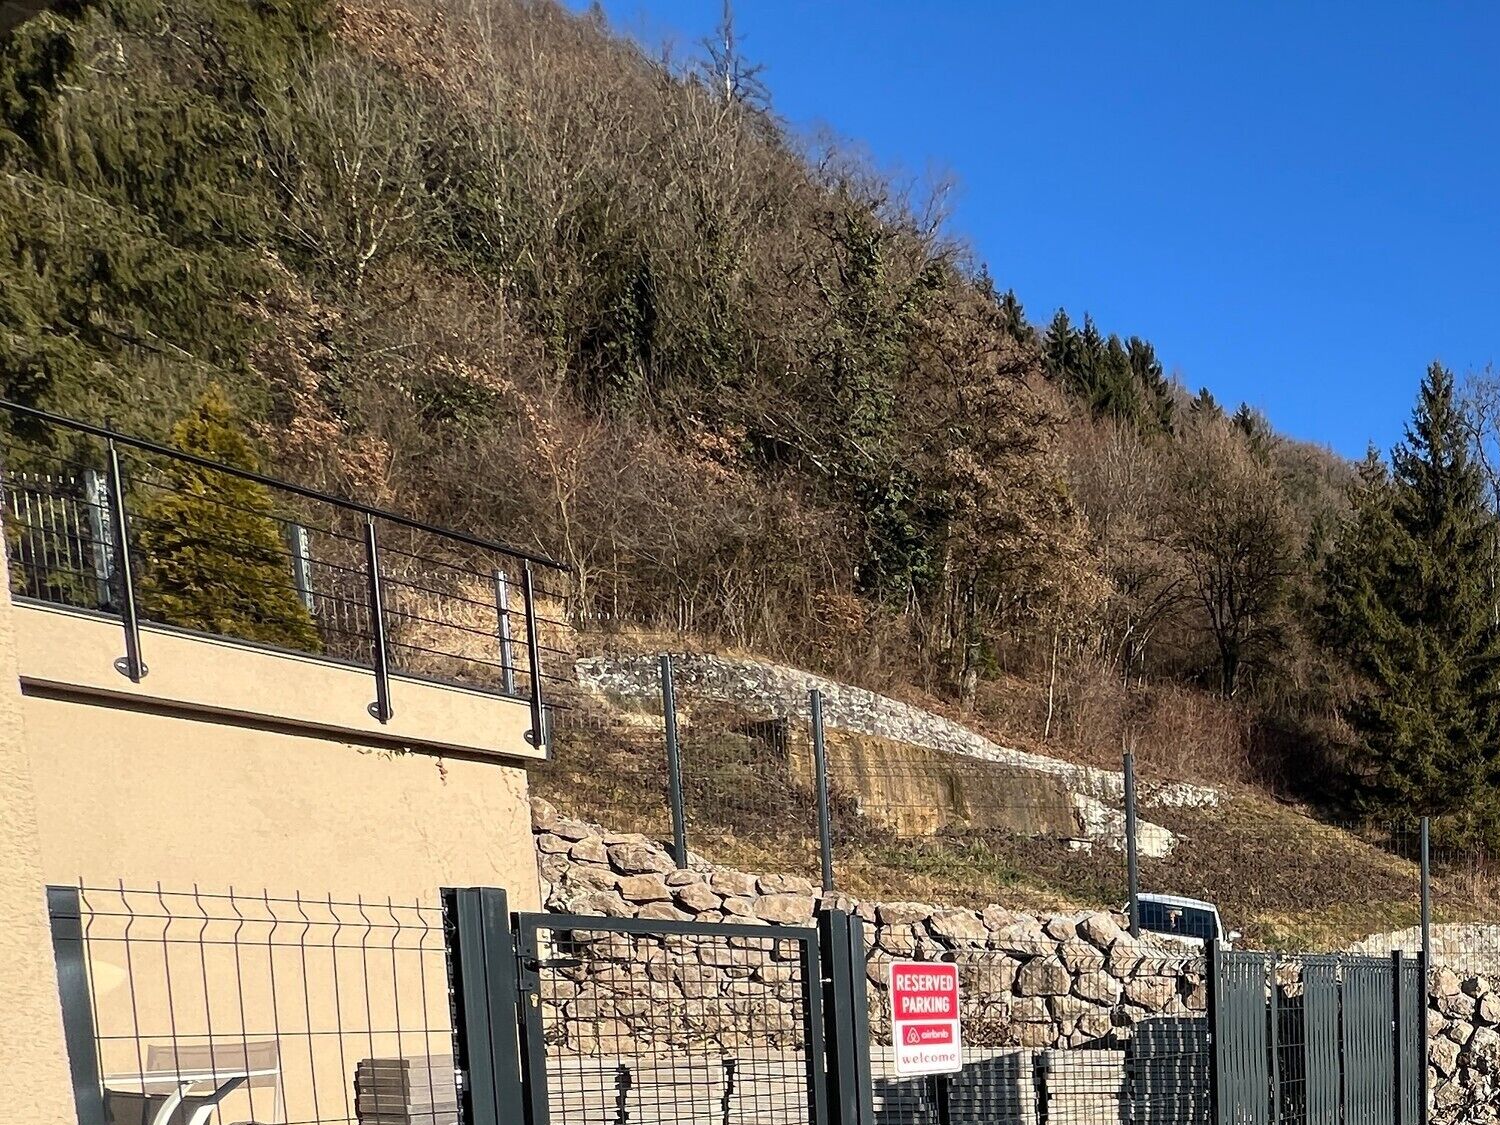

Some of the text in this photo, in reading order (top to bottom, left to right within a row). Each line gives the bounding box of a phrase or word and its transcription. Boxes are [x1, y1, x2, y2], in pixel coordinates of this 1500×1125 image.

[896, 974, 954, 992] RESERVED
[902, 996, 950, 1013] PARKING
[921, 1028, 949, 1039] airbnb
[902, 1052, 956, 1064] welcome
